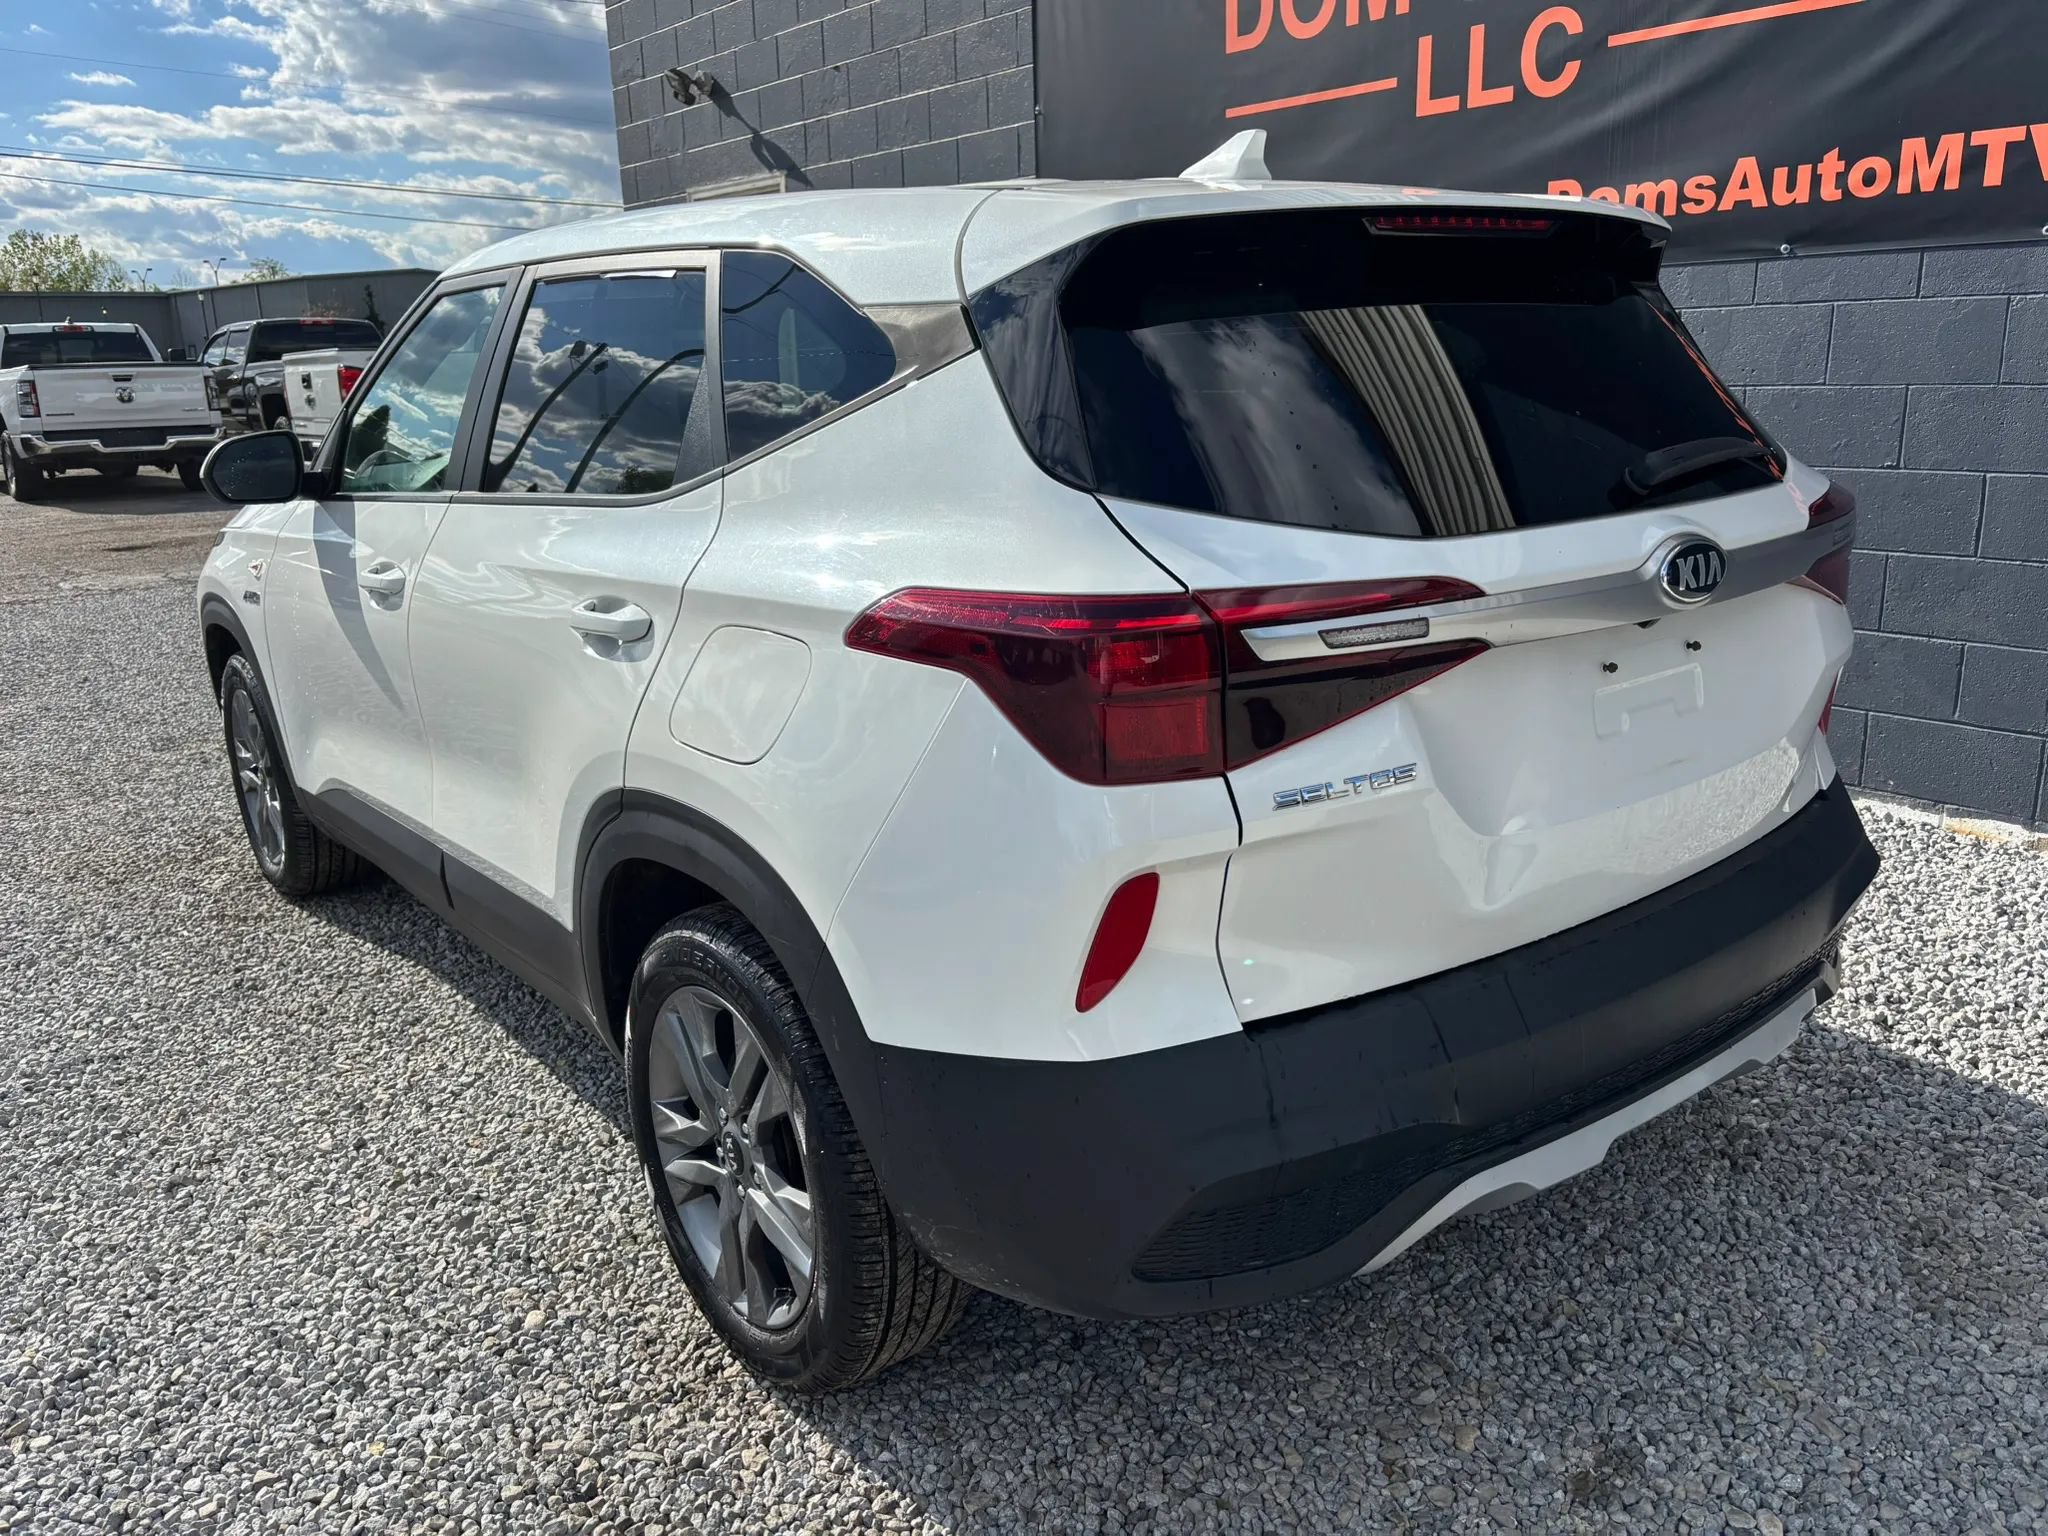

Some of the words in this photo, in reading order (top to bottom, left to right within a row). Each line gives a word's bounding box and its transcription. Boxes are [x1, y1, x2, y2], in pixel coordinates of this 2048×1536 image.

[1416, 6, 1584, 117] LLC
[1676, 551, 1722, 591] KIA
[1272, 762, 1417, 811] SELTOS
[725, 1137, 738, 1171] KIA
